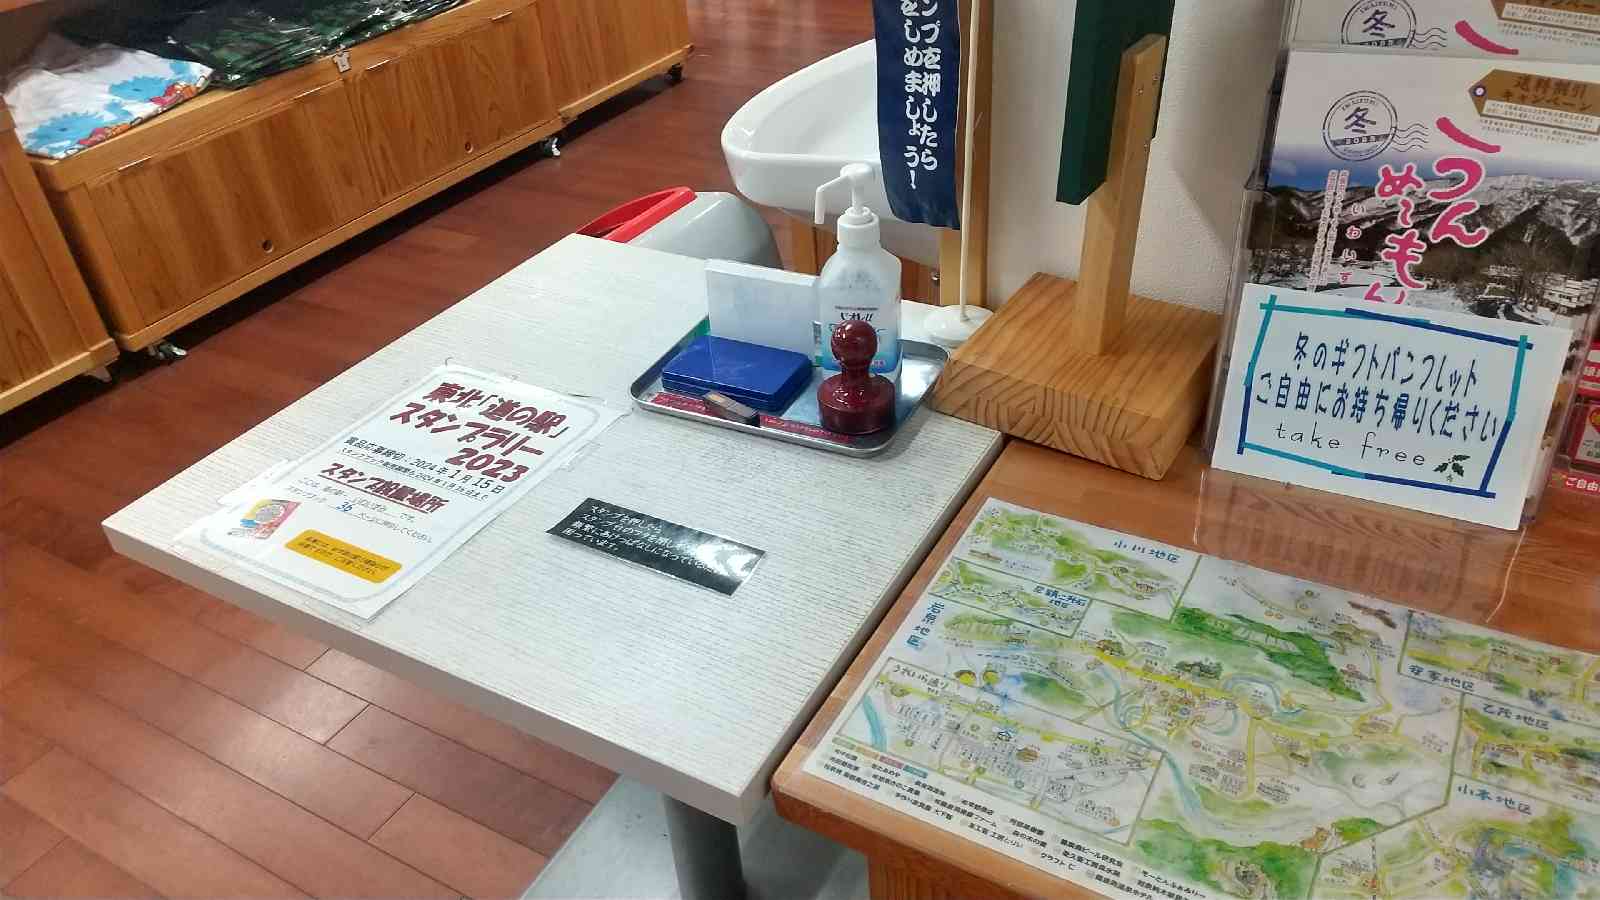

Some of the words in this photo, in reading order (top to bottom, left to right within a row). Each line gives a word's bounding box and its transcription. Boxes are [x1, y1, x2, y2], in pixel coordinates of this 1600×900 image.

[1362, 9, 1396, 38] 冬
[1344, 106, 1377, 134] 冬
[1293, 331, 1477, 397] 冬のギフトパンフレット
[422, 382, 569, 439] 東北「道の駅」
[1256, 372, 1498, 442] ご自由にお持ち帰りください
[390, 402, 544, 457] スタンプラリー
[1276, 422, 1341, 450] take
[1361, 431, 1425, 466] free
[445, 448, 530, 483] 2023
[1566, 477, 1600, 491] ご自由
[321, 463, 449, 513] スタンプ設置場所
[1114, 539, 1181, 564] 小川地区
